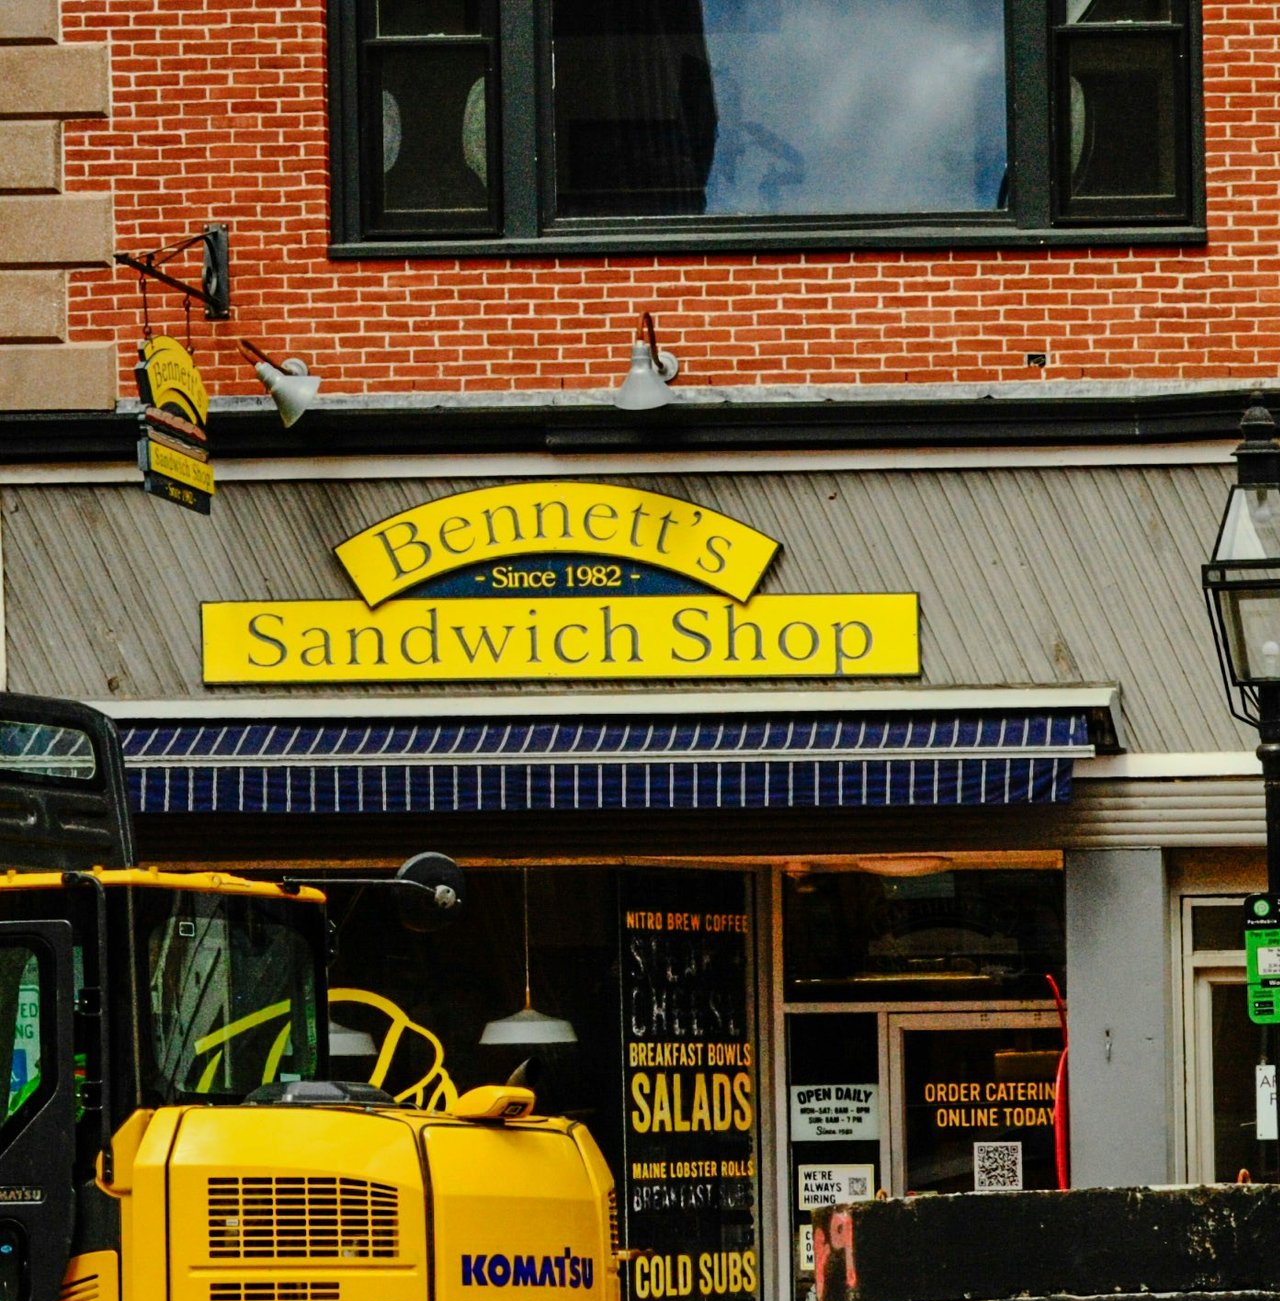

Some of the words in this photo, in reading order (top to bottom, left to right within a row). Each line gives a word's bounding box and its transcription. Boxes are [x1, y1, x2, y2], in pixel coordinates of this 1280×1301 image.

[153, 360, 204, 408] Bennett's
[154, 447, 190, 479] Sandwich
[192, 466, 211, 491] Shop
[373, 499, 734, 582] Bennett's
[492, 565, 557, 588] Since
[566, 565, 621, 589] 1982
[247, 606, 641, 668] Sandwich
[671, 603, 874, 675] Shop
[627, 911, 663, 929] NITRO
[667, 913, 700, 931] BREW
[705, 914, 750, 933] COFFEE
[630, 1042, 703, 1067] BREAKFAST
[708, 1043, 751, 1067] BOWLS
[631, 1072, 753, 1133] SALADS
[797, 1088, 831, 1104] OPEN
[835, 1087, 873, 1103] DAILY
[925, 1083, 980, 1102] ORDER
[985, 1082, 1056, 1101] CATERIN
[937, 1108, 998, 1127] ONLINE
[1003, 1107, 1055, 1126] TODAY
[633, 1162, 667, 1179] MAINE
[670, 1160, 718, 1178] LOBSTER
[721, 1159, 755, 1176] ROLLS
[804, 1171, 833, 1181] WE'RE
[804, 1182, 842, 1192] ALWAYS
[804, 1194, 836, 1204] HIRING
[461, 1247, 594, 1290] KOMATSU
[635, 1254, 693, 1299] COLD
[699, 1251, 757, 1295] SUBS
